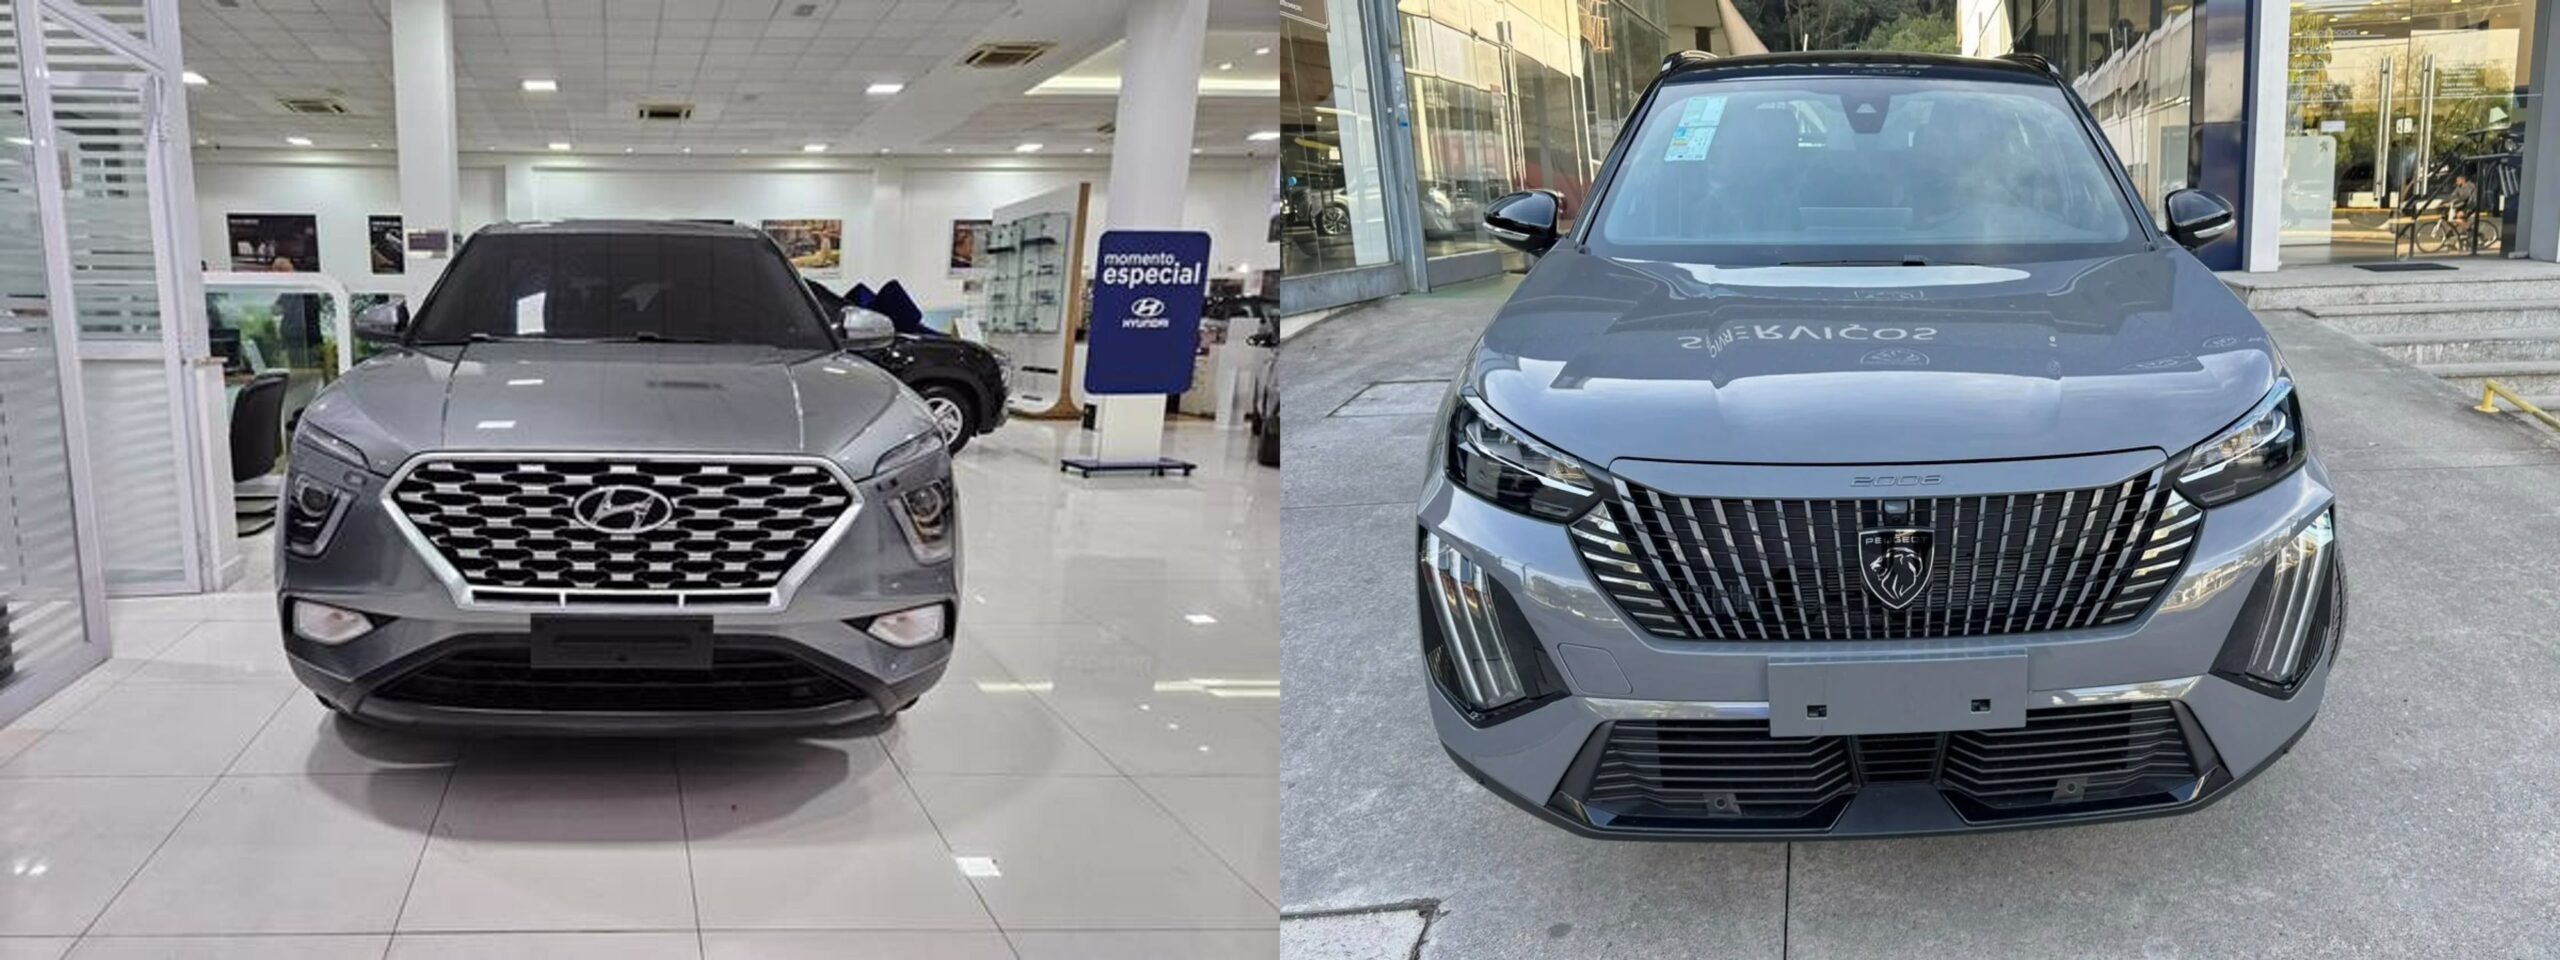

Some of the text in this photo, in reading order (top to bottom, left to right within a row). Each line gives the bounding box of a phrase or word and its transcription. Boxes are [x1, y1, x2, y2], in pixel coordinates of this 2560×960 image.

[1104, 252, 1174, 266] momento
[1103, 262, 1201, 288] especial
[1122, 319, 1169, 328] HYUNDAI
[1850, 475, 1942, 487] 2008
